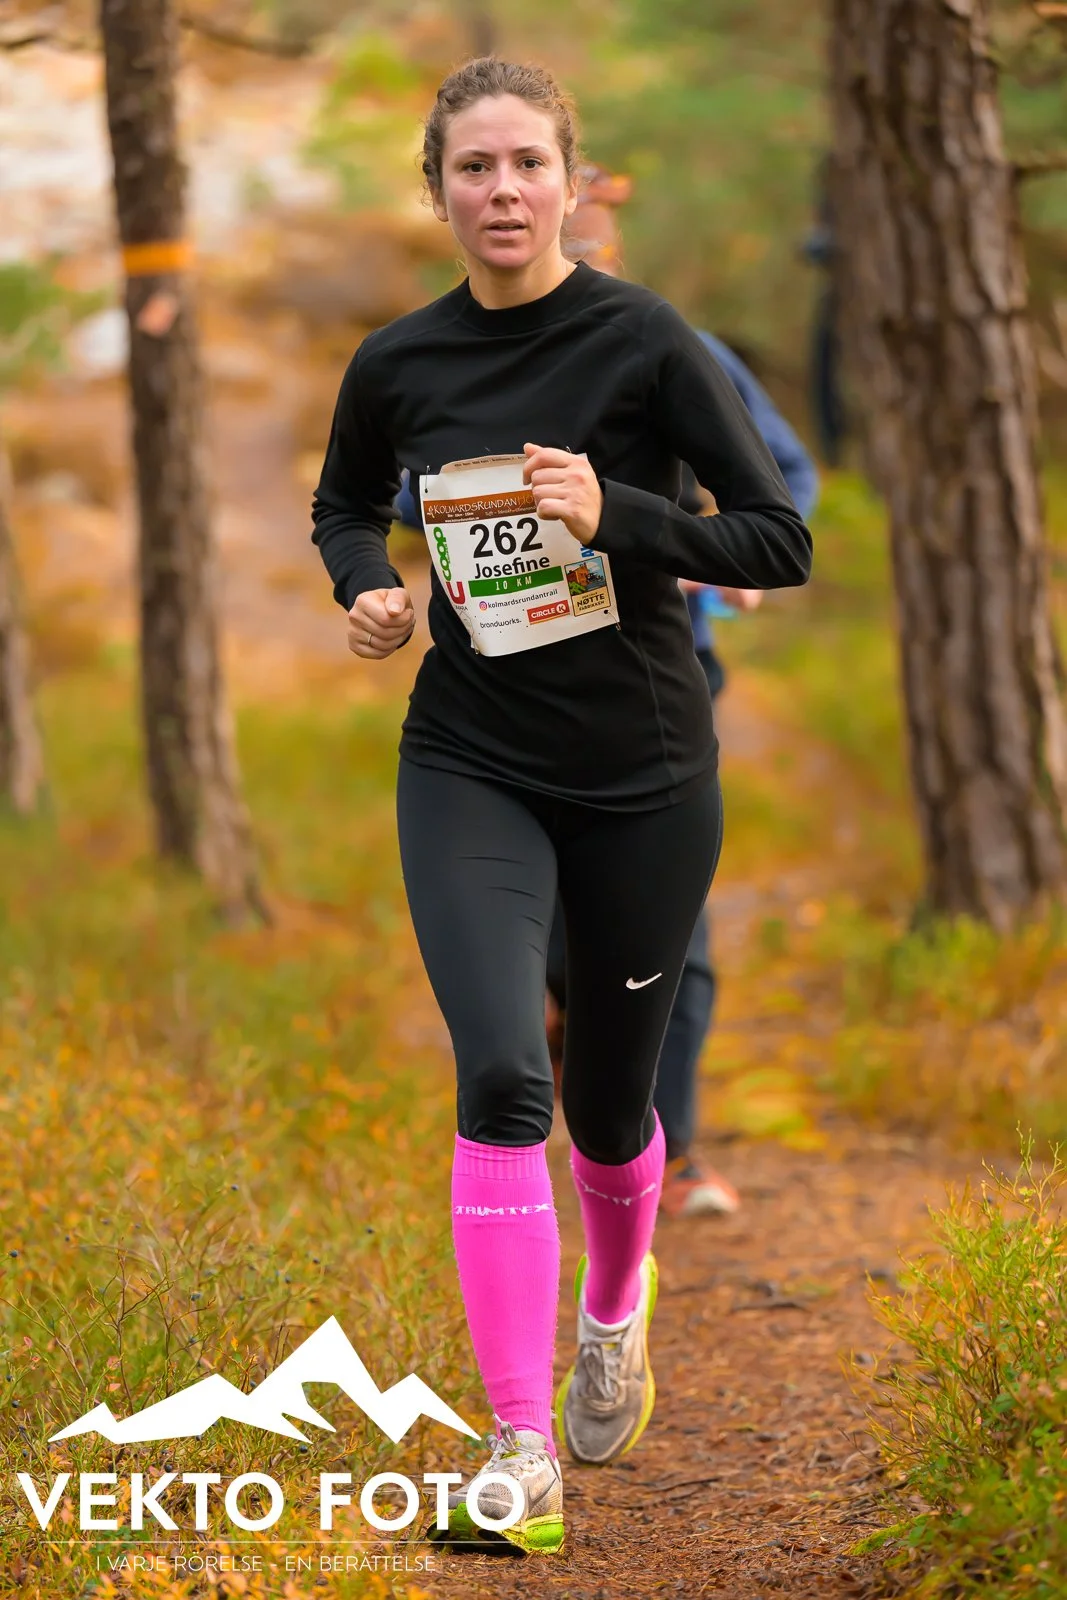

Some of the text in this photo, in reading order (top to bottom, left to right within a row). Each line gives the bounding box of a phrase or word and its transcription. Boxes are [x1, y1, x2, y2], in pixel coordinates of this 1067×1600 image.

[469, 517, 543, 558] 262
[474, 556, 550, 579] Josefine
[495, 576, 532, 590] 10 KM
[487, 589, 558, 608] kolmardsrundantrail
[531, 607, 556, 618] CIRCLE
